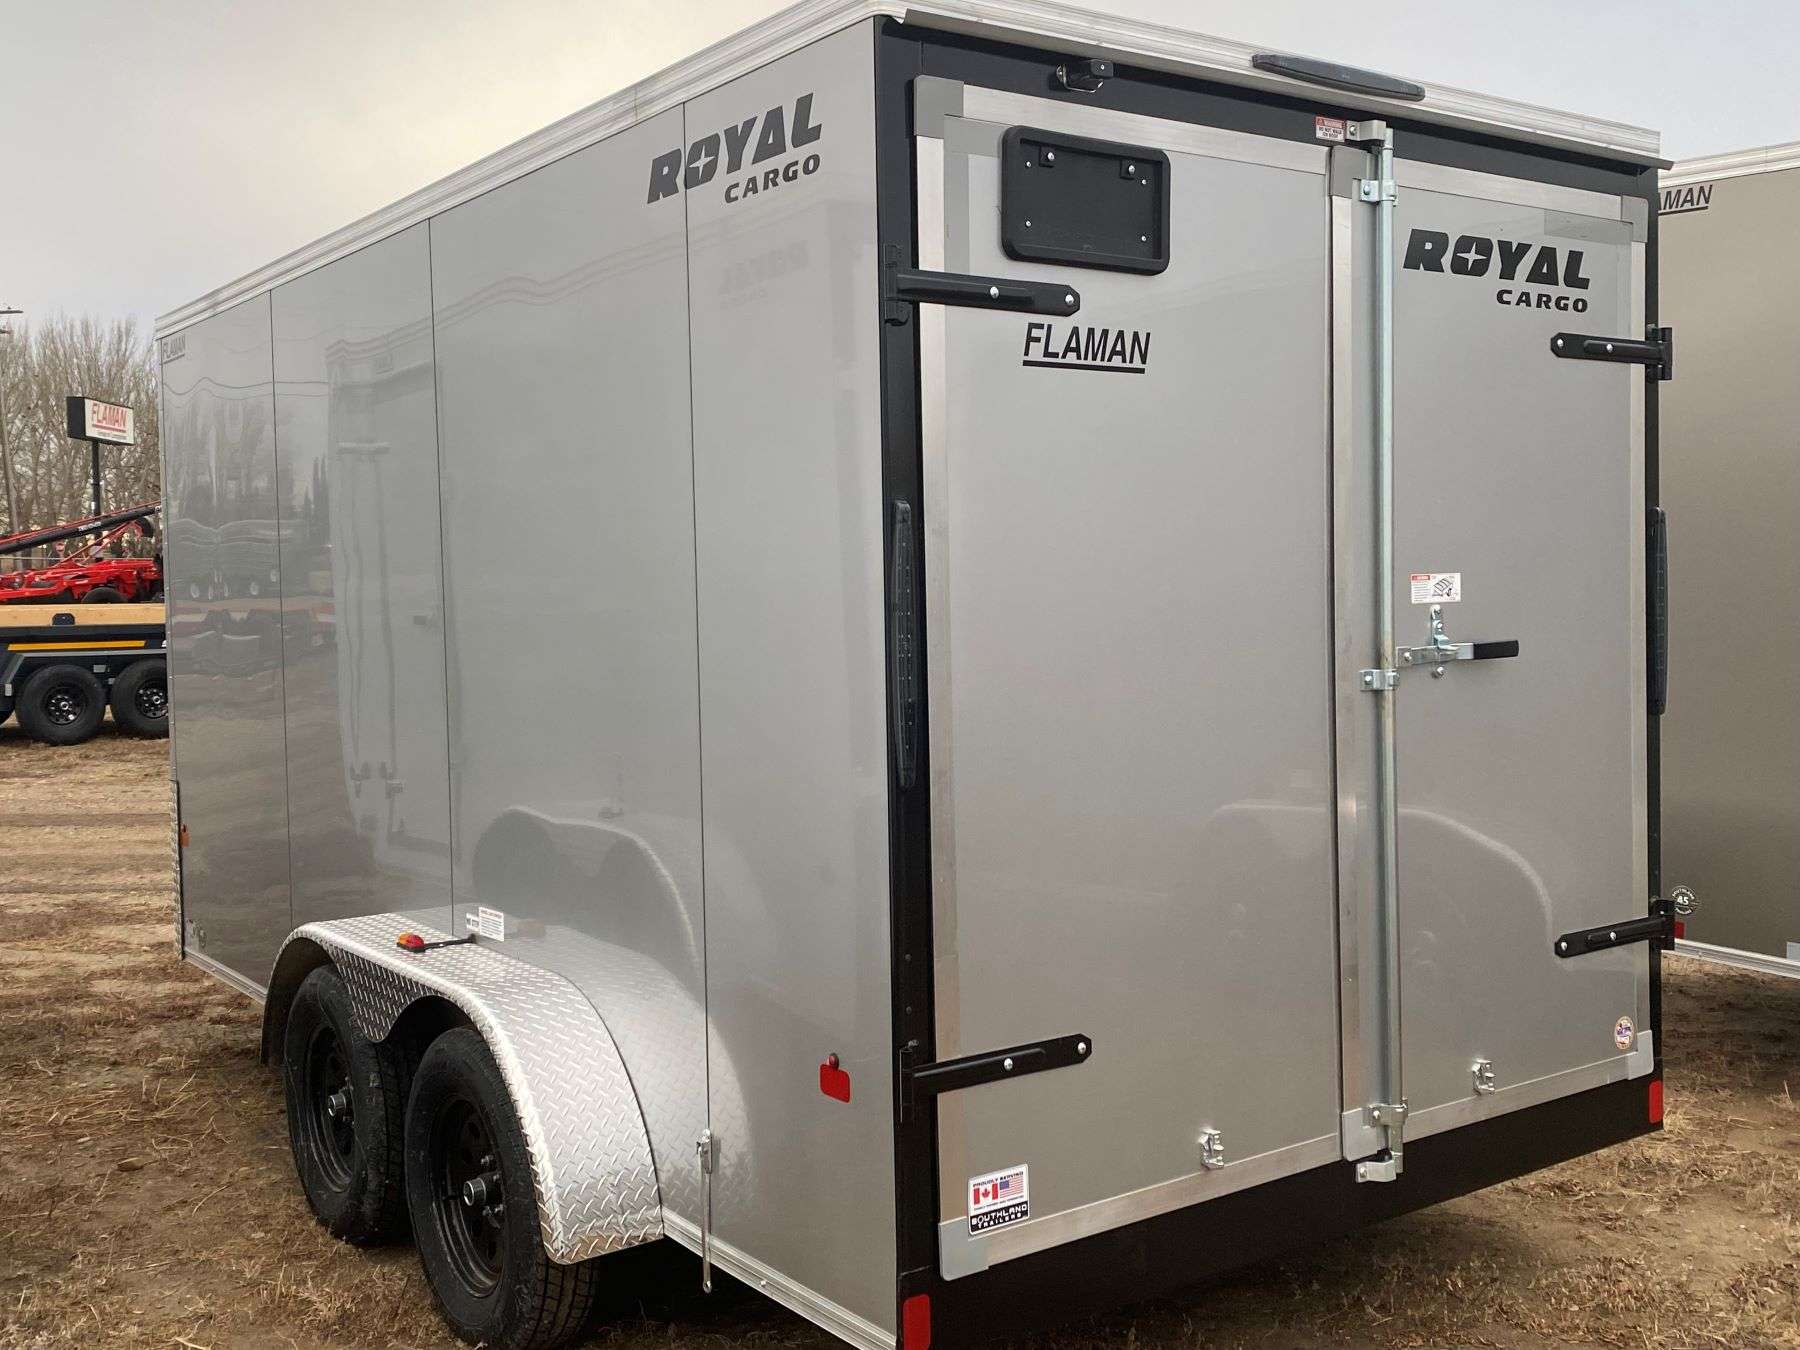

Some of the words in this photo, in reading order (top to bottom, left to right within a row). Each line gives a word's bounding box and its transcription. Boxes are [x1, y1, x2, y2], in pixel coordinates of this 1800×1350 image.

[647, 92, 823, 205] ROYAL
[724, 153, 821, 204] CARGO
[1658, 184, 1713, 211] MAN
[1403, 228, 1591, 290] ROYAL
[1496, 289, 1588, 313] CARGO
[1023, 322, 1151, 365] FLAMAN
[91, 401, 127, 428] FLAMAN
[972, 1204, 1027, 1225] SOUTHLAND
[978, 1212, 1022, 1229] TRAILERS
